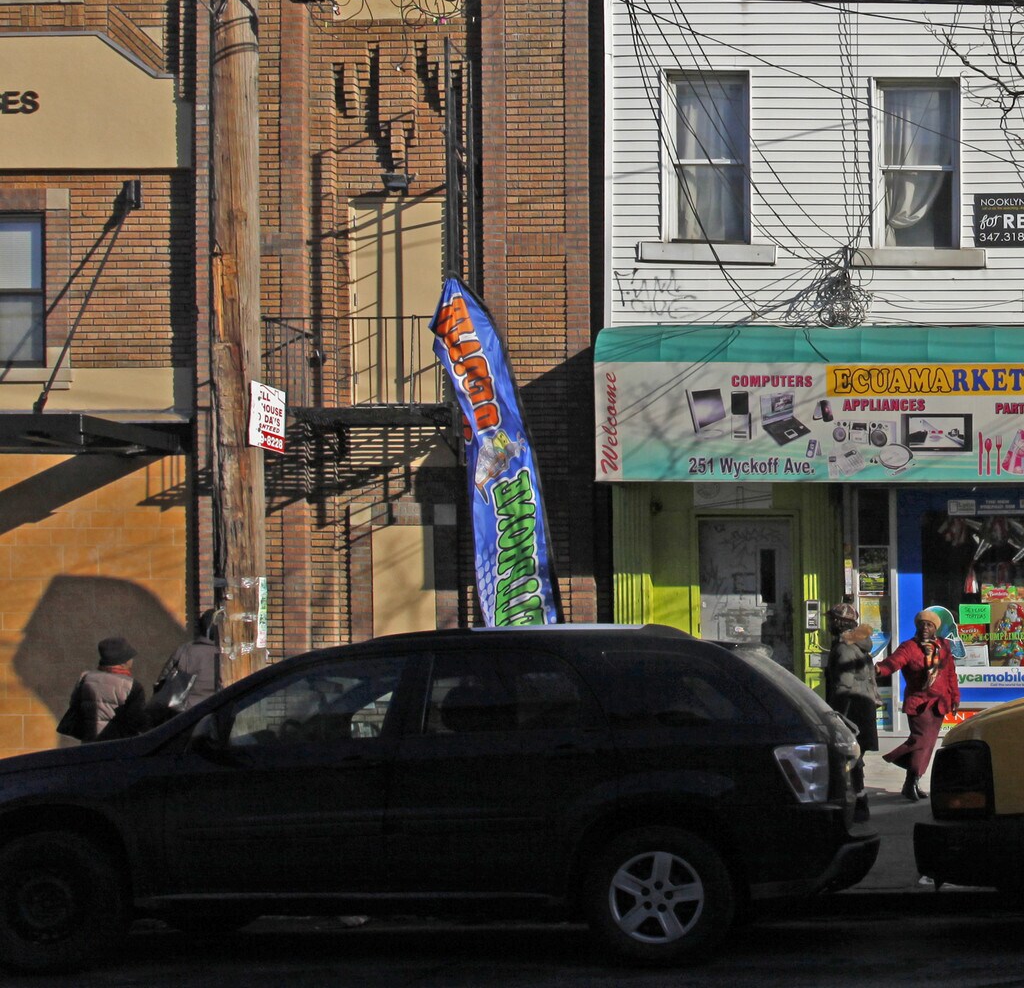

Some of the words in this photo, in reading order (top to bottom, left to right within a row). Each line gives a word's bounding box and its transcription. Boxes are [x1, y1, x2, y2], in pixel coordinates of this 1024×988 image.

[0, 91, 40, 115] ES
[980, 214, 1002, 230] for
[731, 375, 813, 388] COMPUTERS
[833, 367, 1024, 393] ECUAMARKET
[842, 398, 926, 412] APPLIANCES
[601, 372, 619, 474] Welcome
[689, 457, 715, 474] 251
[720, 457, 779, 478] Wyckoff
[783, 458, 815, 474] Ave.
